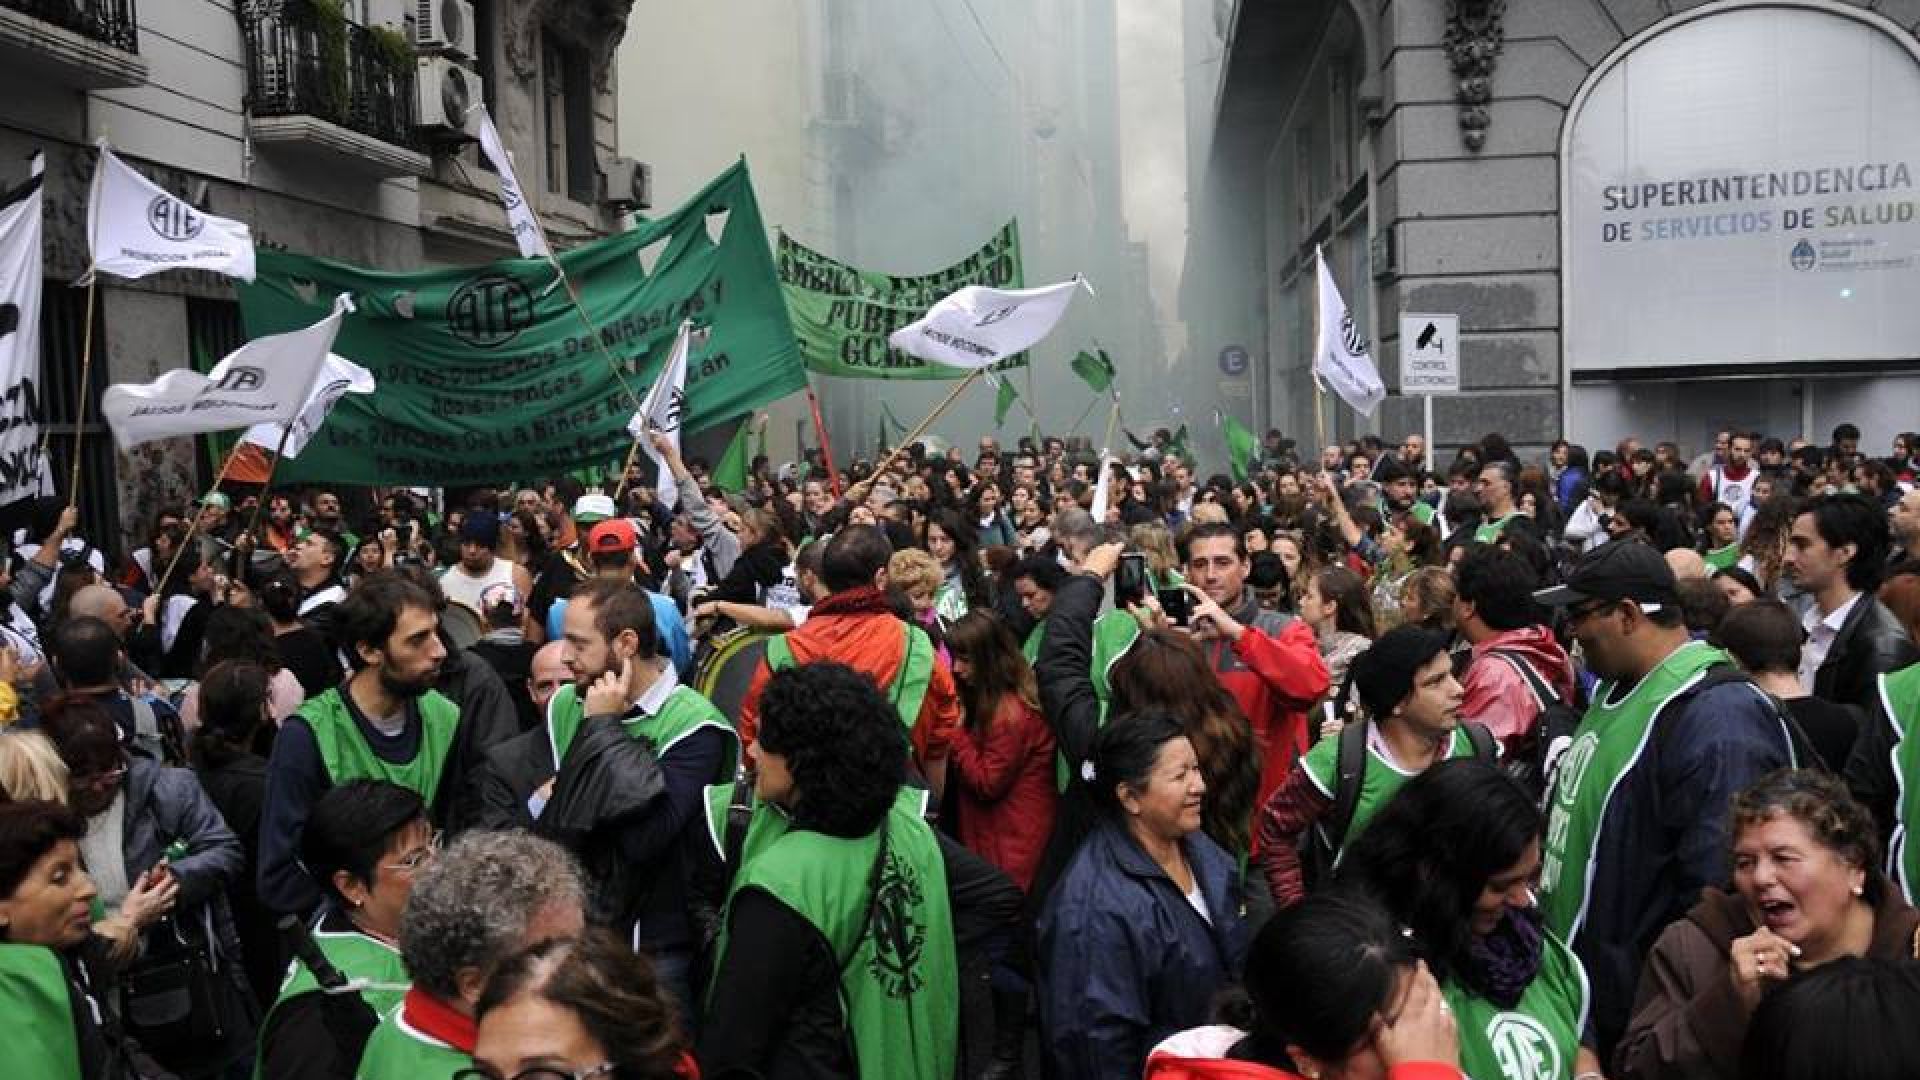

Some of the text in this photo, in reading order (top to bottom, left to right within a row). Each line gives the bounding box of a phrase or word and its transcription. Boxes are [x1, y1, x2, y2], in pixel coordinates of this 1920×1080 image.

[1603, 162, 1912, 211] SUPERINTENDENCIA
[1603, 202, 1914, 242] DE SERVICIOS DE SALUD
[457, 283, 531, 338] ATE
[1228, 350, 1242, 370] E
